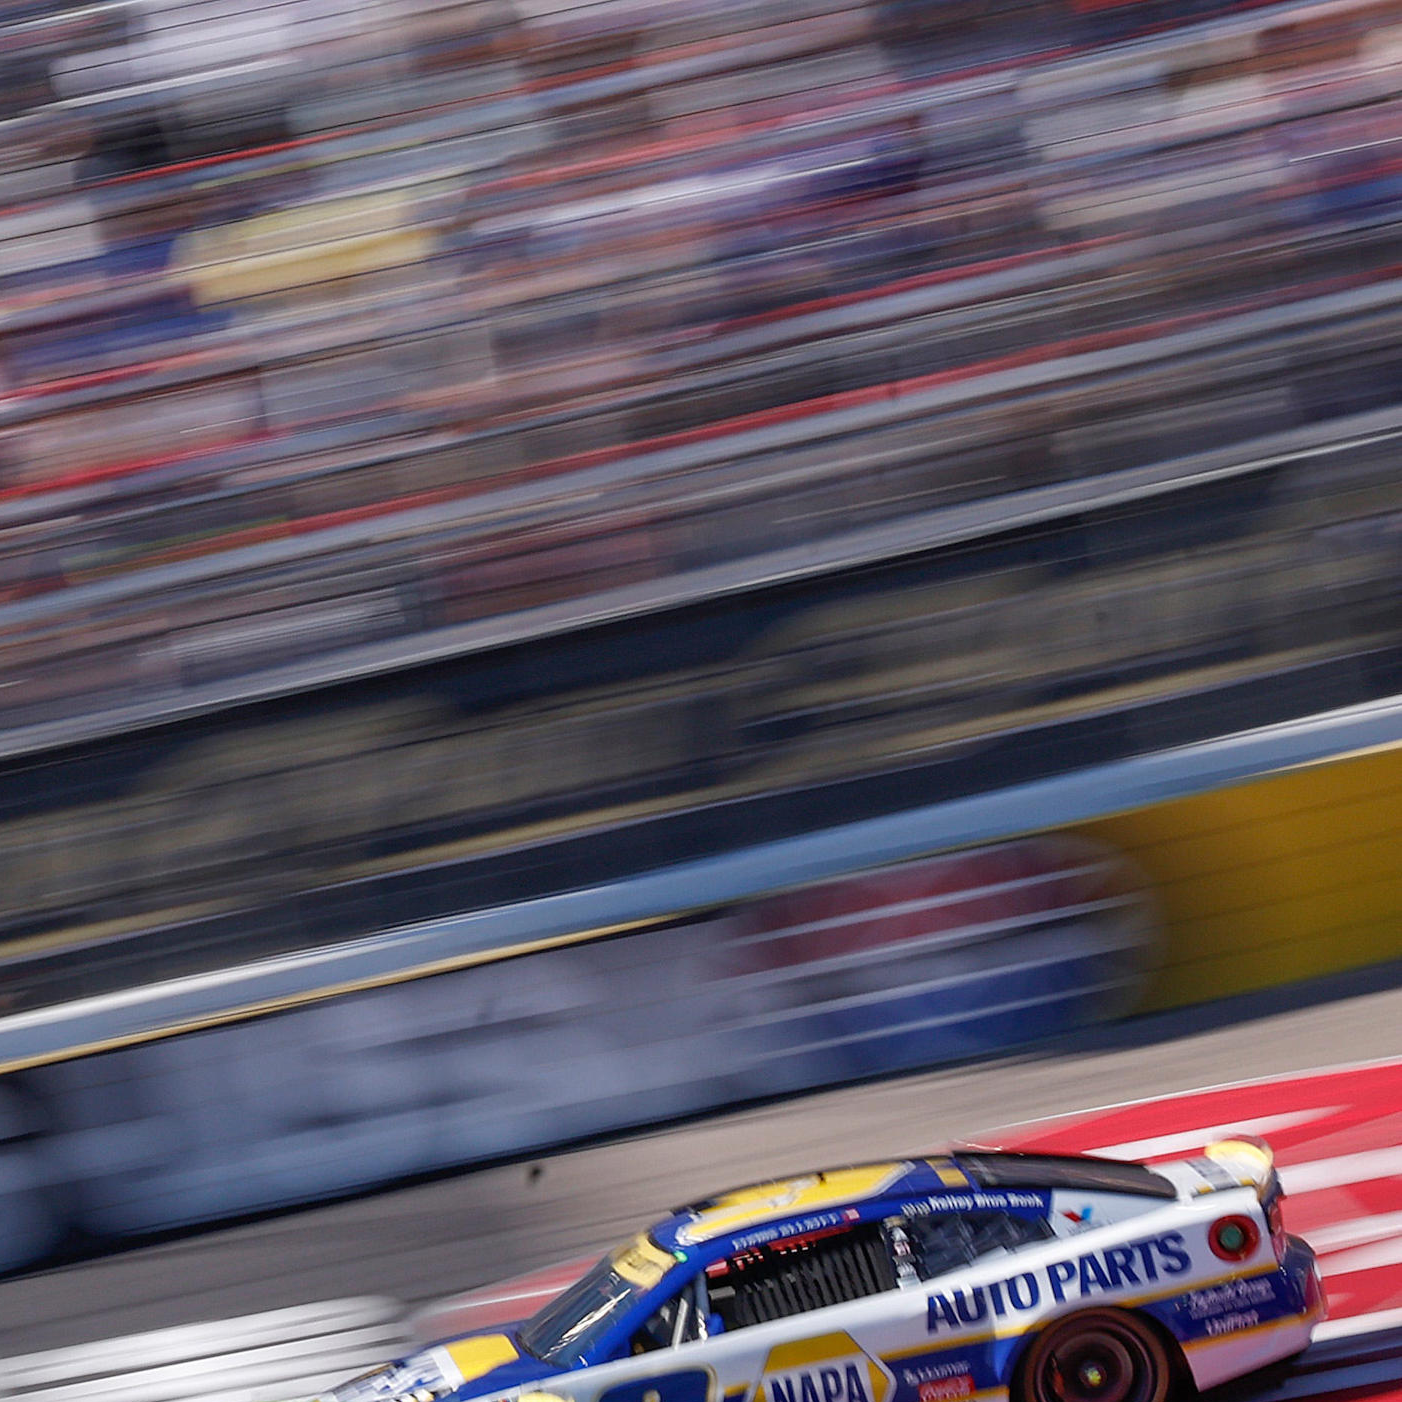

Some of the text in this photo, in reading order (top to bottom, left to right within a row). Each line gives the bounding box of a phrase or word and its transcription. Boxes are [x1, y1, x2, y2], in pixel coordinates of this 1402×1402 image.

[974, 1193, 1007, 1207] Blue
[1008, 1193, 1044, 1208] Book
[925, 1270, 1040, 1335] AUTO
[1046, 1231, 1192, 1303] PARTS
